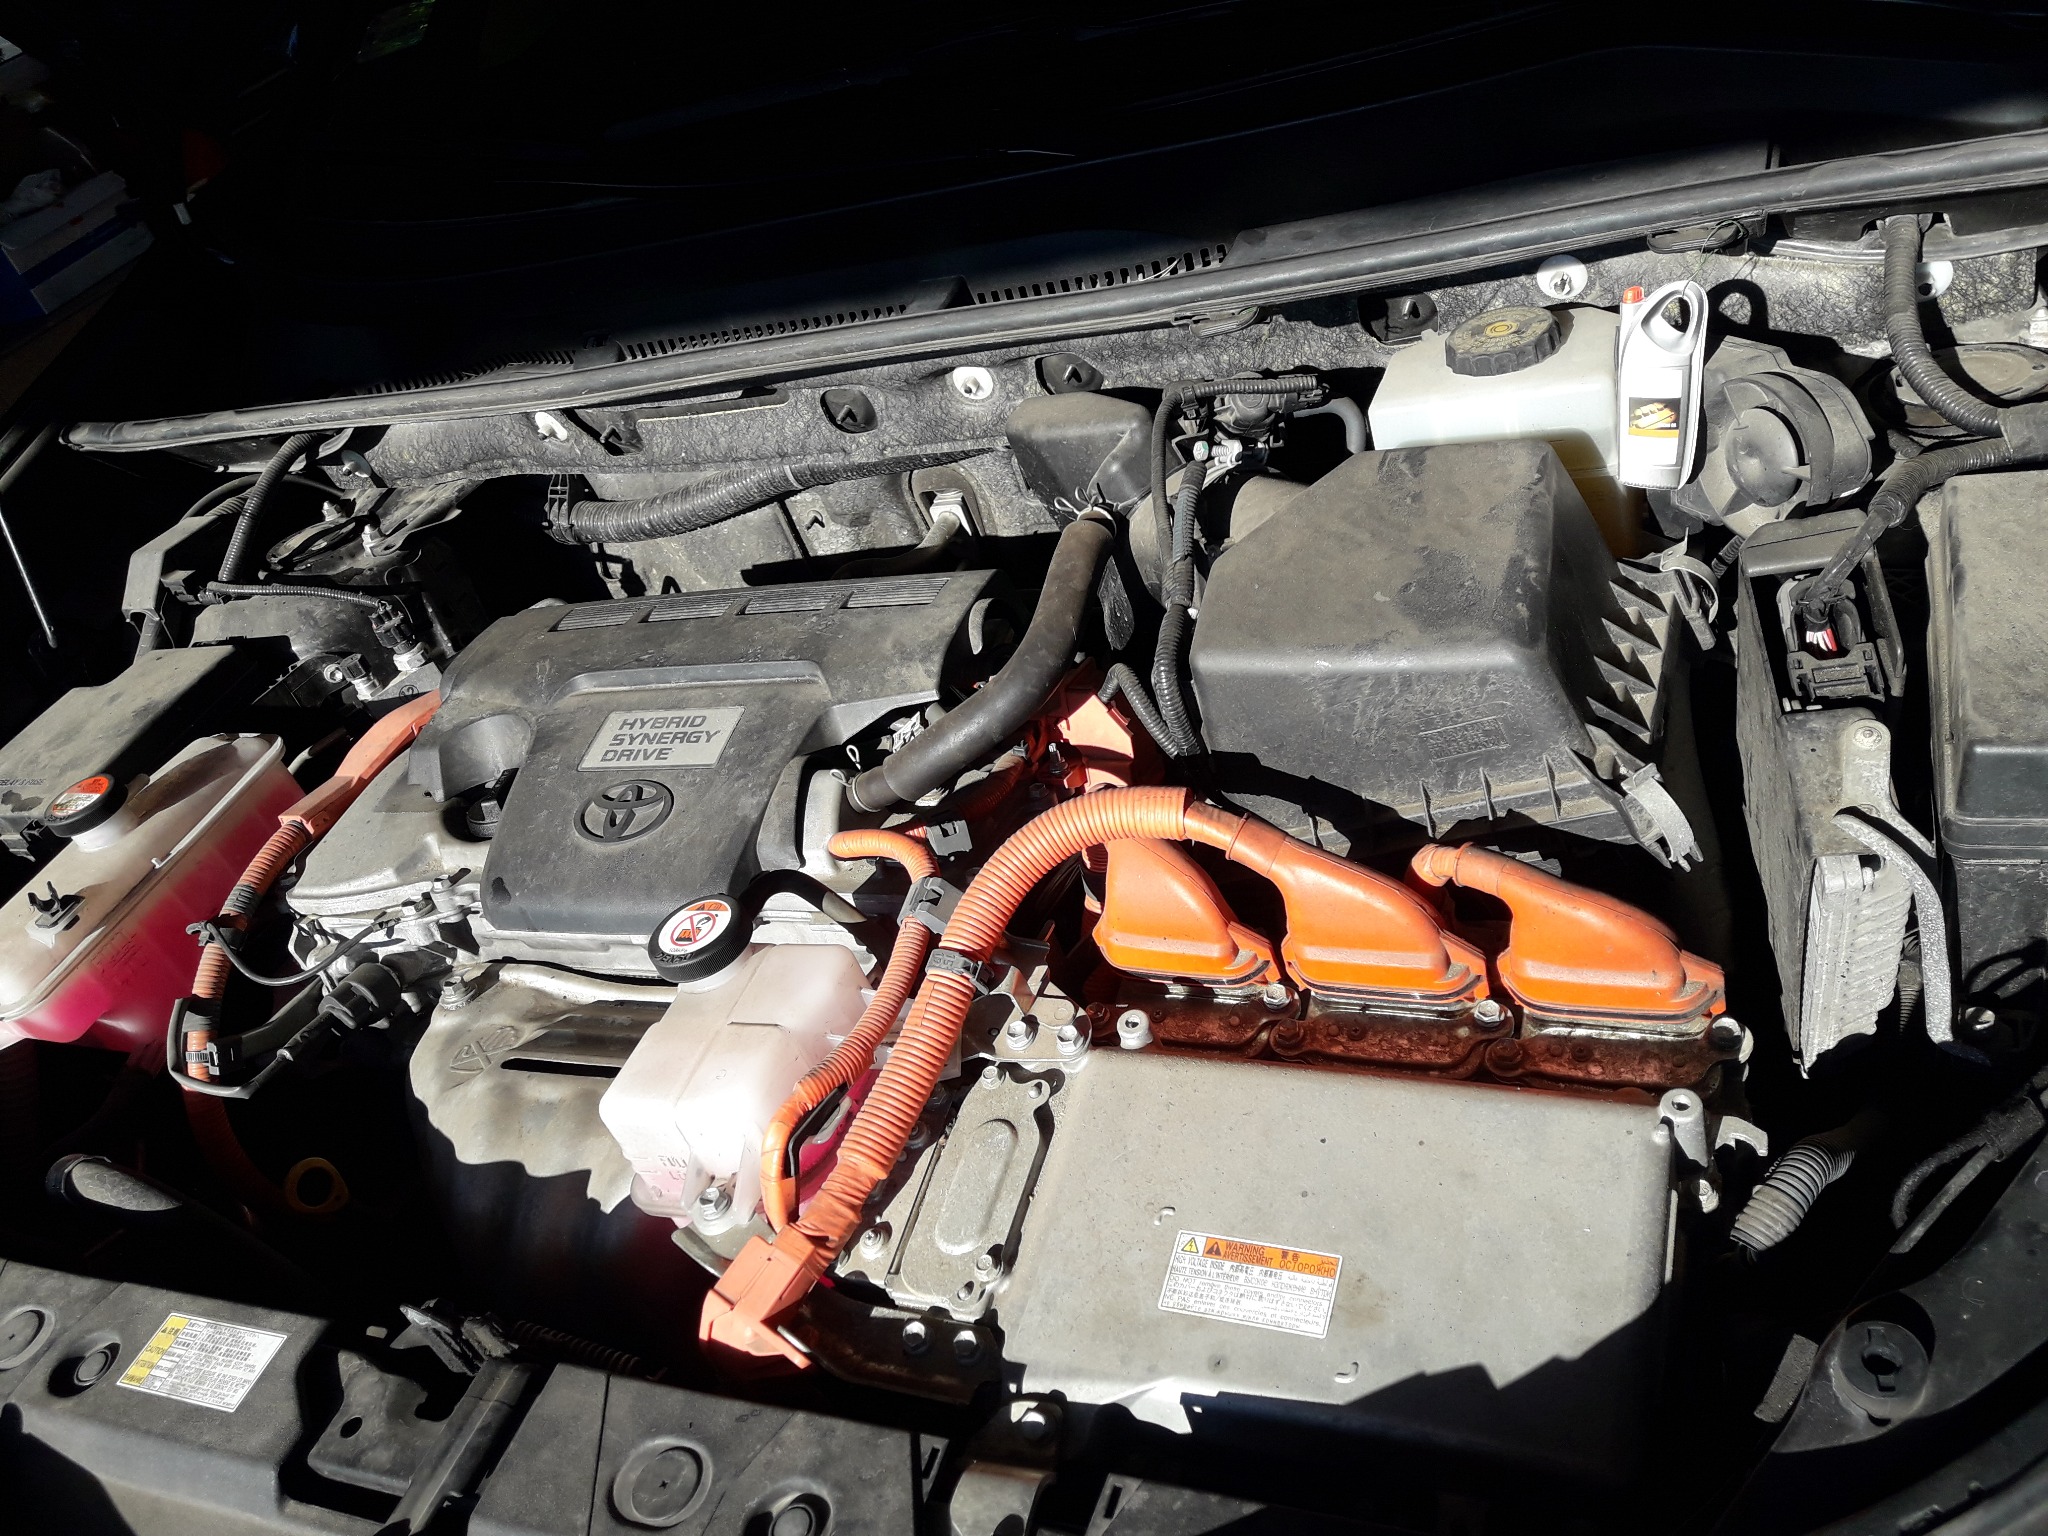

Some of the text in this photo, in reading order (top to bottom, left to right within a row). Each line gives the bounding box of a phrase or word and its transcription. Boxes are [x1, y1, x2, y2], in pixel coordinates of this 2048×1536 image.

[618, 715, 708, 731] HYBRID
[609, 730, 719, 746] SYNERGY
[600, 747, 674, 762] DRIVE
[654, 951, 694, 964] DENSO
[1224, 1240, 1265, 1256] WARNING
[1222, 1250, 1272, 1266] AVERTISSEMENT
[1278, 1259, 1335, 1277] ОСТОРОЖНО
[1177, 1295, 1190, 1303] PAS
